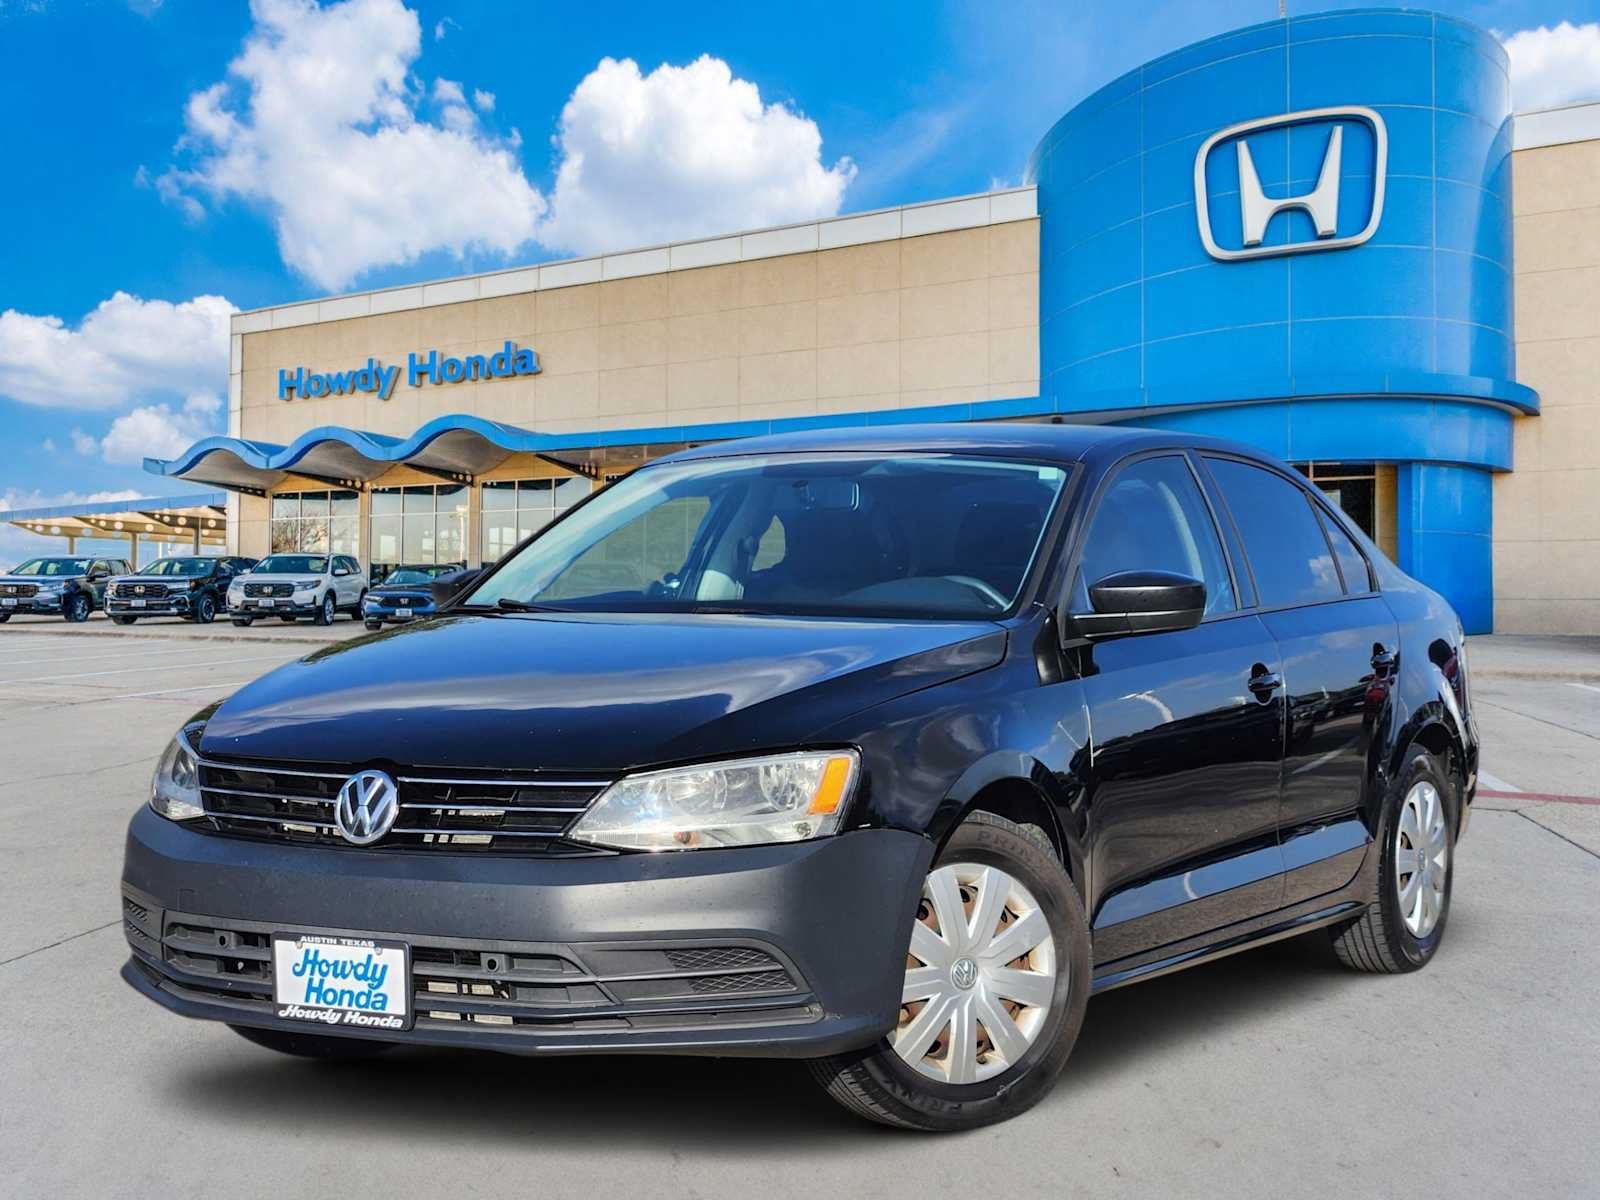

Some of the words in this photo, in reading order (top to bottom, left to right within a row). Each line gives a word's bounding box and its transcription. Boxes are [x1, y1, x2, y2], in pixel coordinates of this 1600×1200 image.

[278, 358, 400, 401] Howdy
[408, 341, 541, 387] Honda
[301, 936, 336, 945] AUSTIN
[340, 938, 375, 947] TEXAS
[292, 948, 389, 990] Howdy
[303, 977, 388, 1011] Honda
[279, 1005, 341, 1024] Howdy
[344, 1011, 403, 1028] Honda
